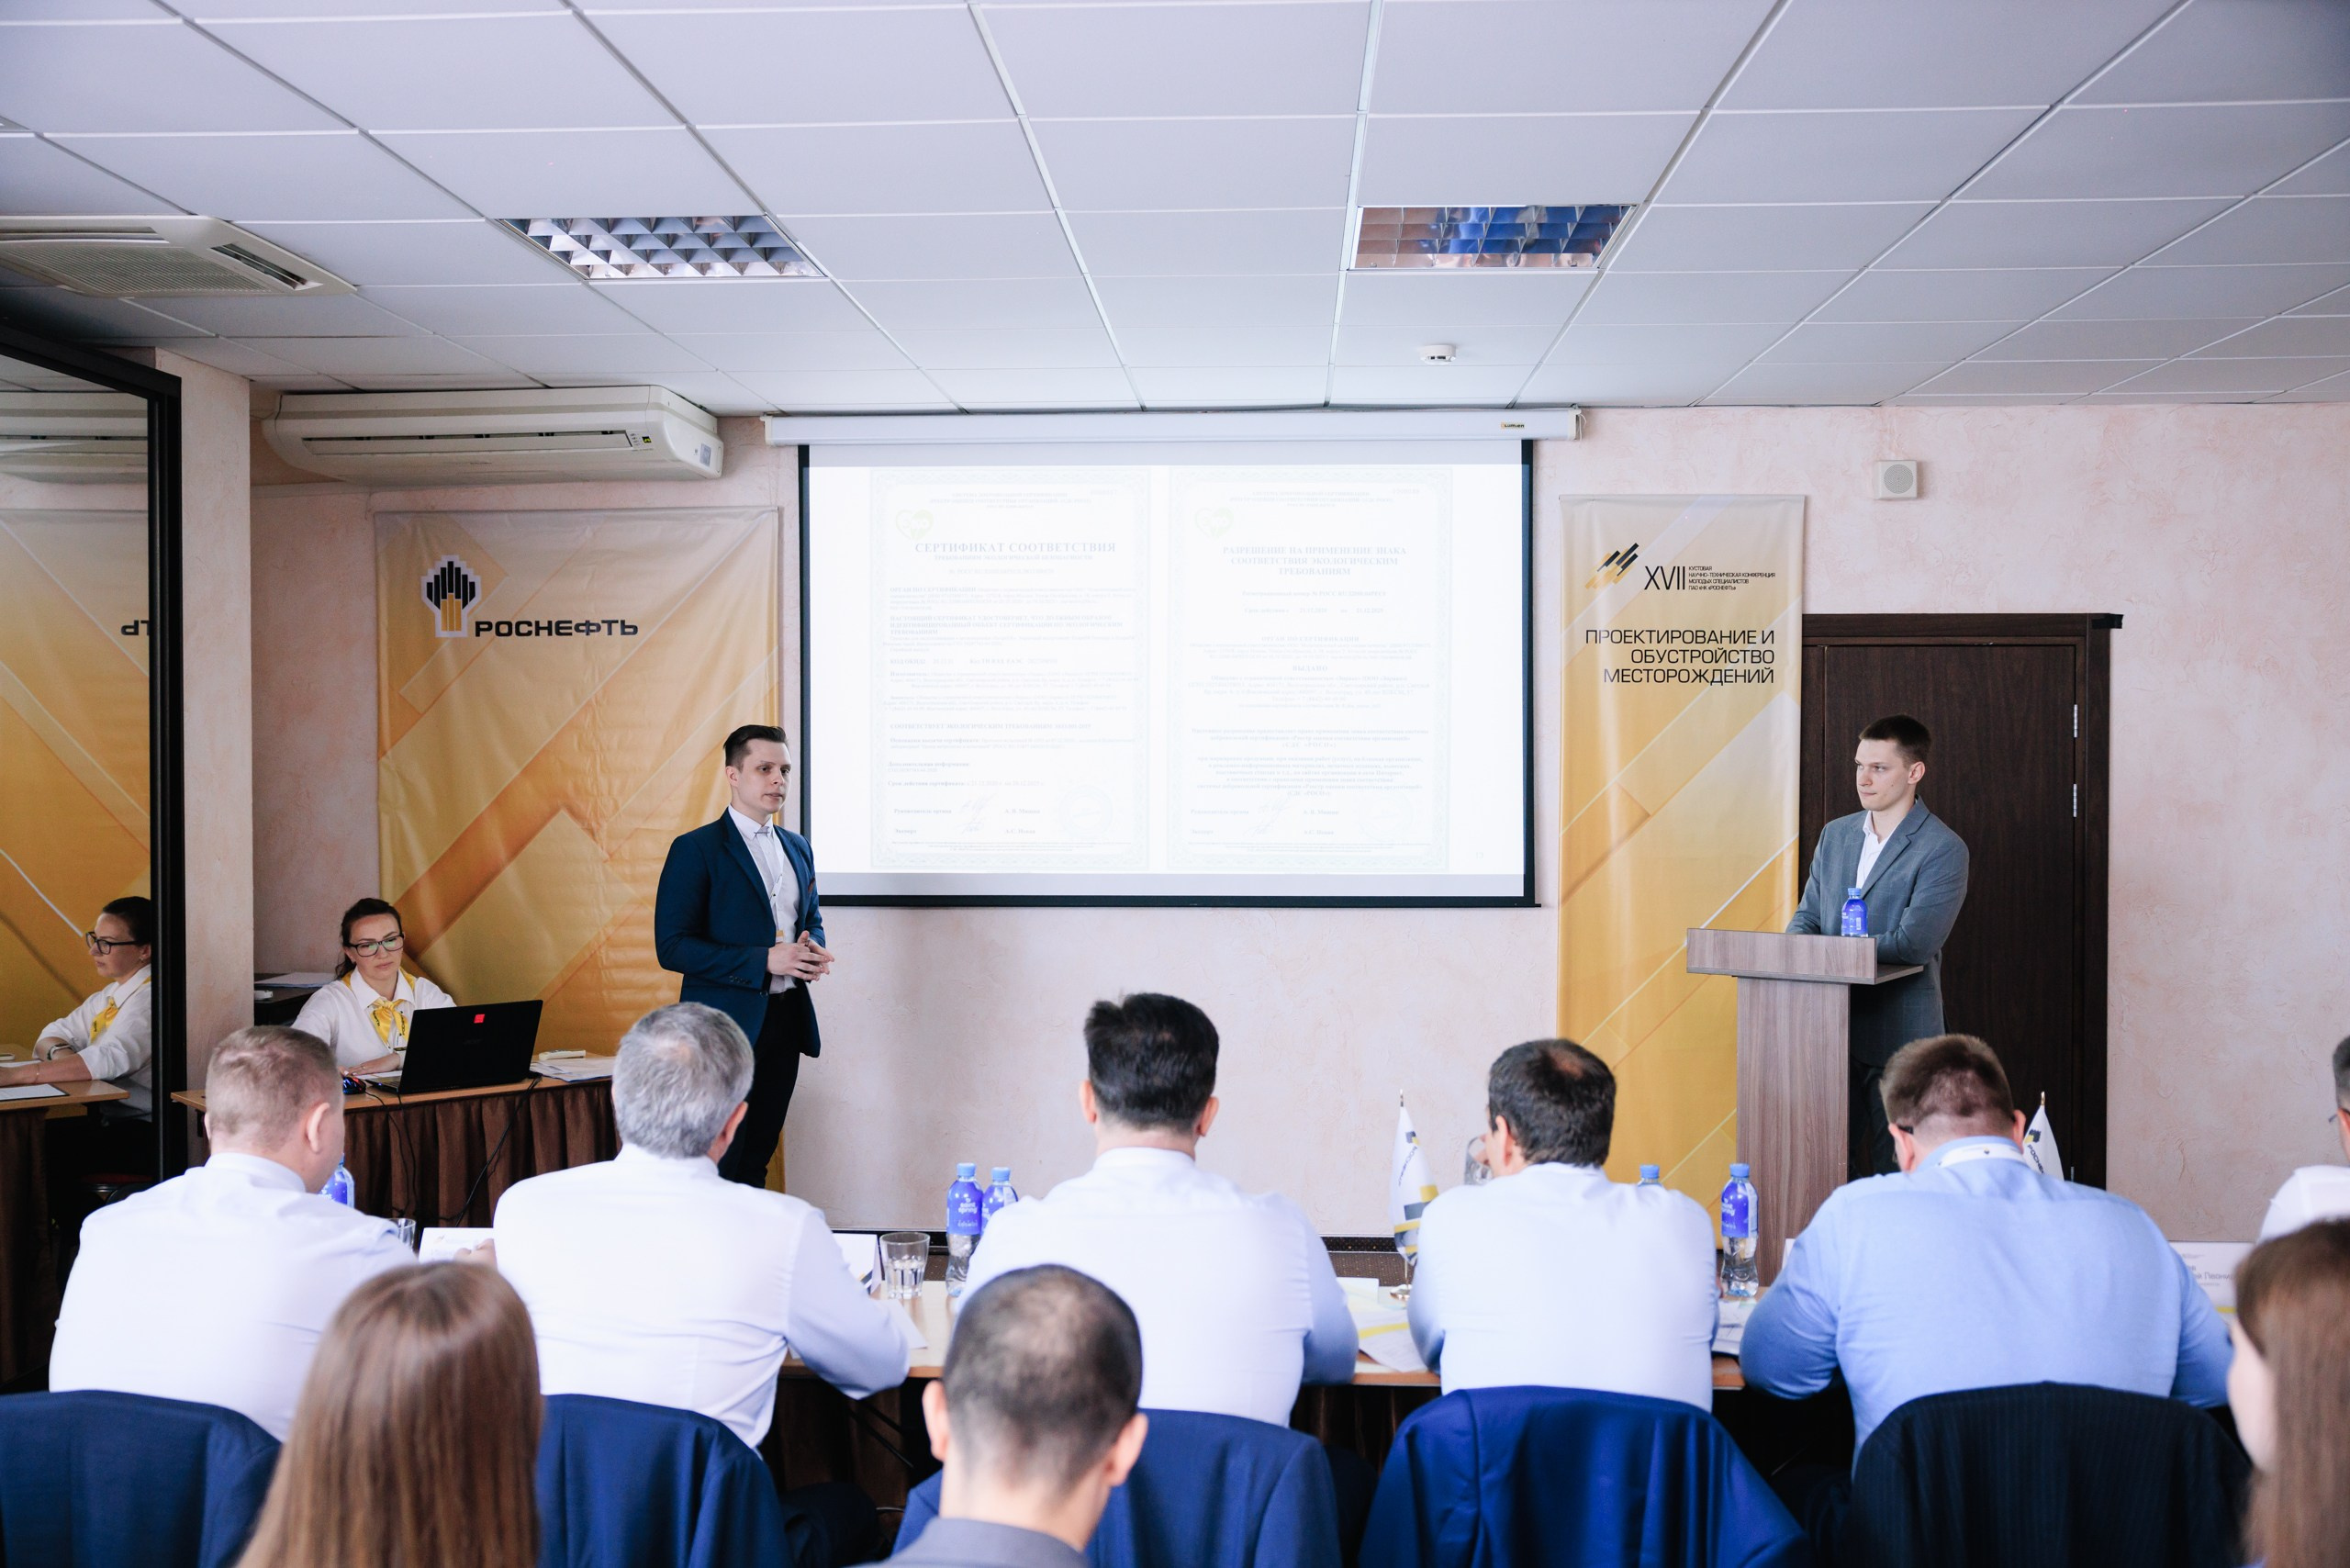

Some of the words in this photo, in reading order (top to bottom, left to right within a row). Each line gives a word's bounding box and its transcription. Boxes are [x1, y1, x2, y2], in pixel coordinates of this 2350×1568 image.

[914, 542, 1005, 553] СЕРТИФИКАТ
[1008, 542, 1116, 553] СООТВЕТСТВИЯ
[1223, 546, 1286, 554] РАЗРЕШЕНИЕ
[1289, 546, 1304, 554] НА
[1305, 546, 1372, 554] ПРИМЕНЕНИЕ
[1376, 546, 1407, 554] ЗНАКА
[1230, 557, 1308, 566] СООТВЕТСТВИЯ
[1311, 557, 1398, 566] ЭКОЛОГИЧЕСКИМ
[1278, 567, 1351, 576] ТРЕБОВАНИЯМ
[1644, 566, 1685, 590] XVII
[475, 620, 638, 637] РОСНЕФТЬ
[1585, 629, 1757, 644] ПРОЕКТИРОВАНИЕ
[1762, 629, 1774, 644] И
[1630, 647, 1774, 664] ОБУСТРОЙСТВО
[1603, 666, 1774, 686] МЕСТОРОЖДЕНИЙ
